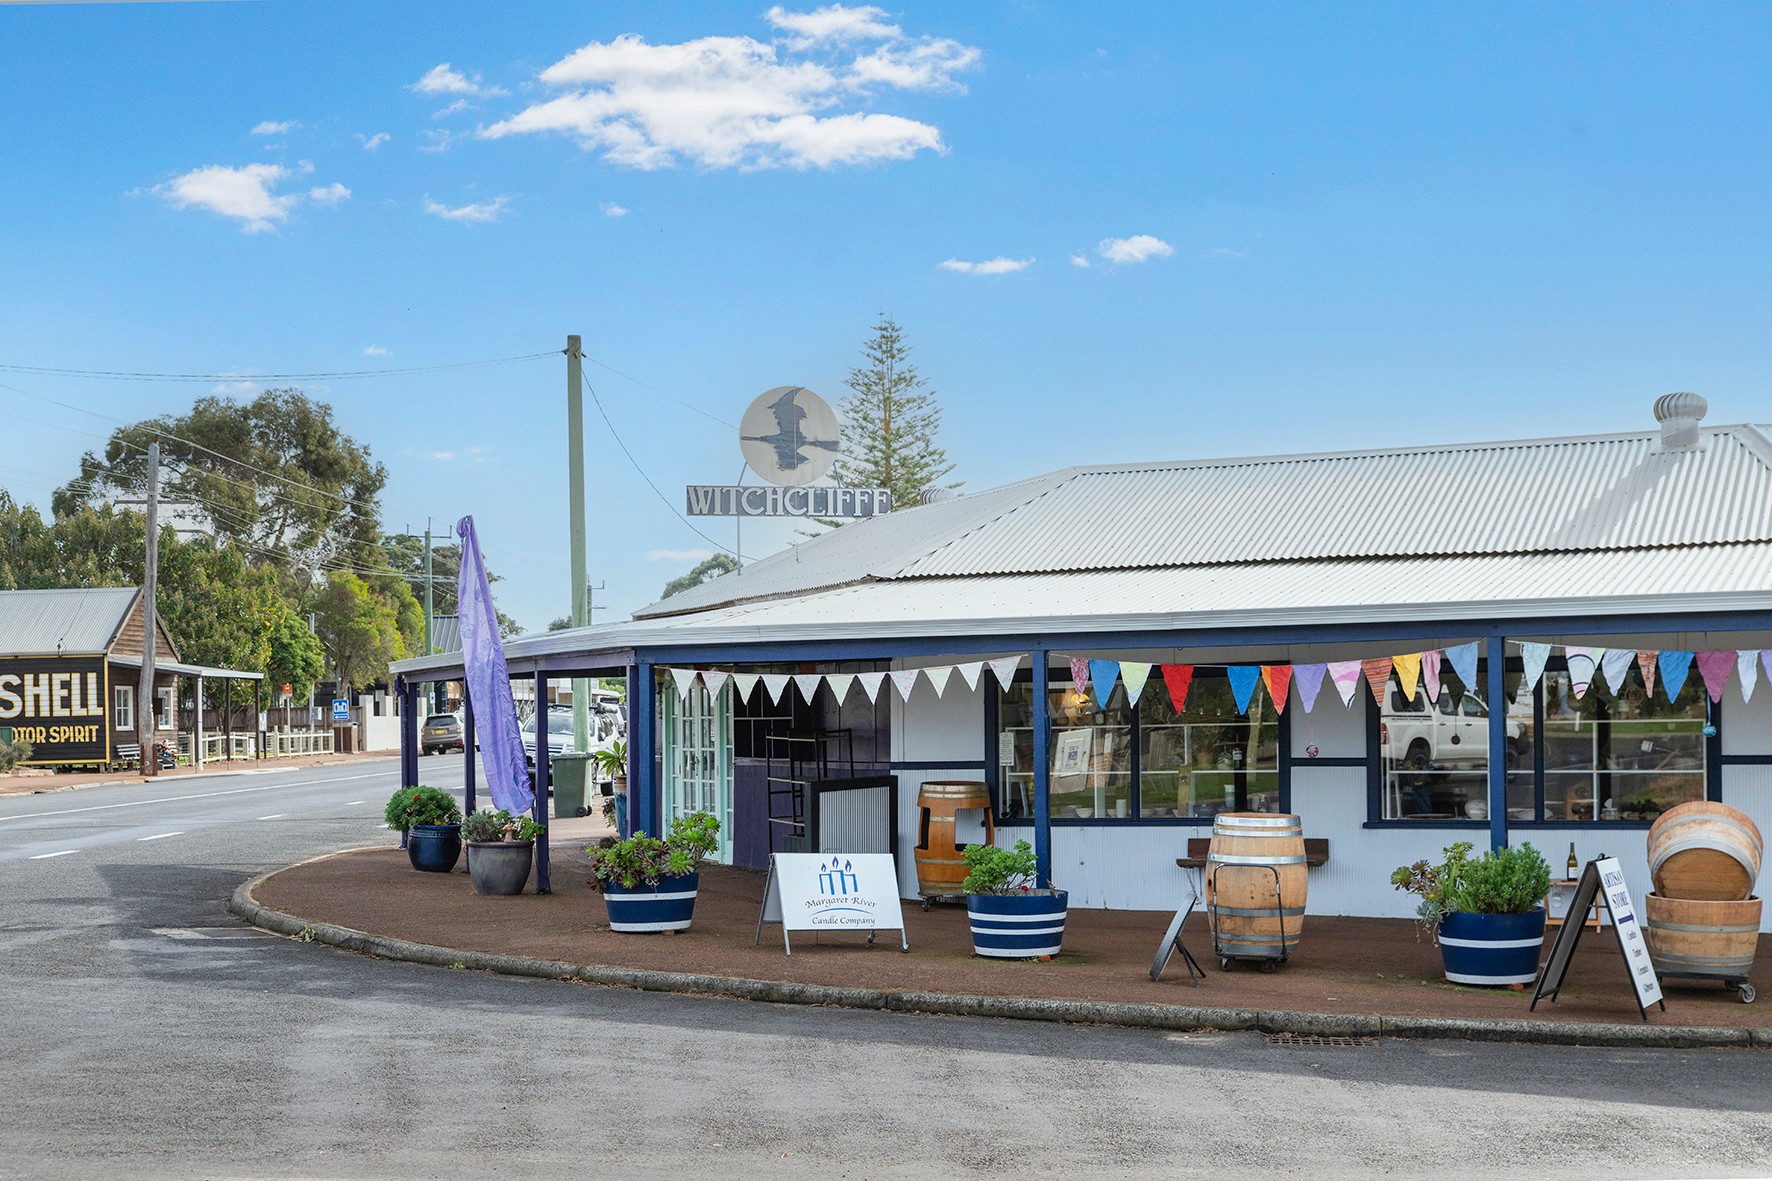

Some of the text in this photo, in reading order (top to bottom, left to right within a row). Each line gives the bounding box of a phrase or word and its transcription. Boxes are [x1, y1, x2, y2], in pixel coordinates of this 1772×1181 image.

[688, 486, 891, 516] WITCHCLIFFE
[0, 672, 103, 719] SHELL
[12, 725, 99, 744] OTOR SPIRIT
[804, 897, 877, 909] Margaret River
[1611, 891, 1629, 909] STORE
[811, 915, 876, 927] Candle Company
